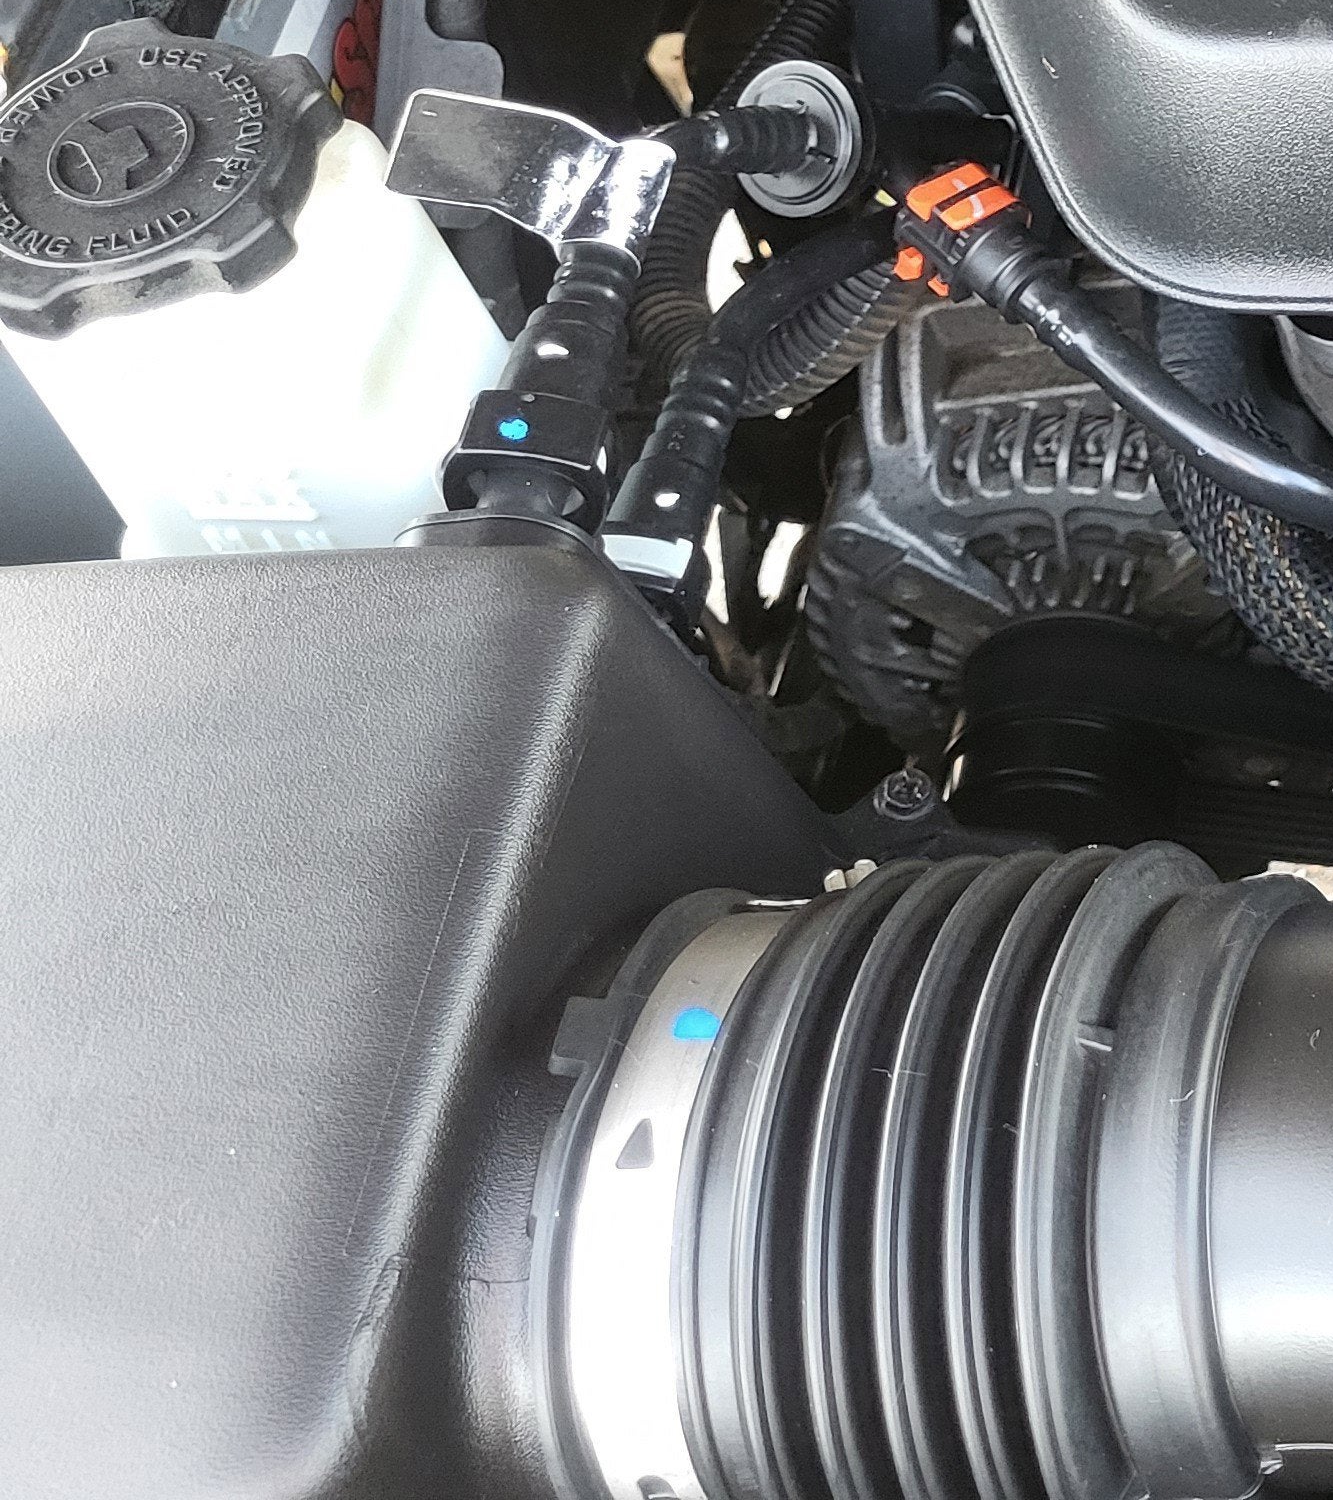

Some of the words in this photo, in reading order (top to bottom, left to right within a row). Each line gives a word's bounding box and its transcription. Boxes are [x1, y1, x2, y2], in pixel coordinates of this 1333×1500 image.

[0, 57, 110, 144] POWER
[86, 207, 191, 257] FLUID
[138, 47, 207, 72] USE
[207, 64, 264, 193] APPROVED
